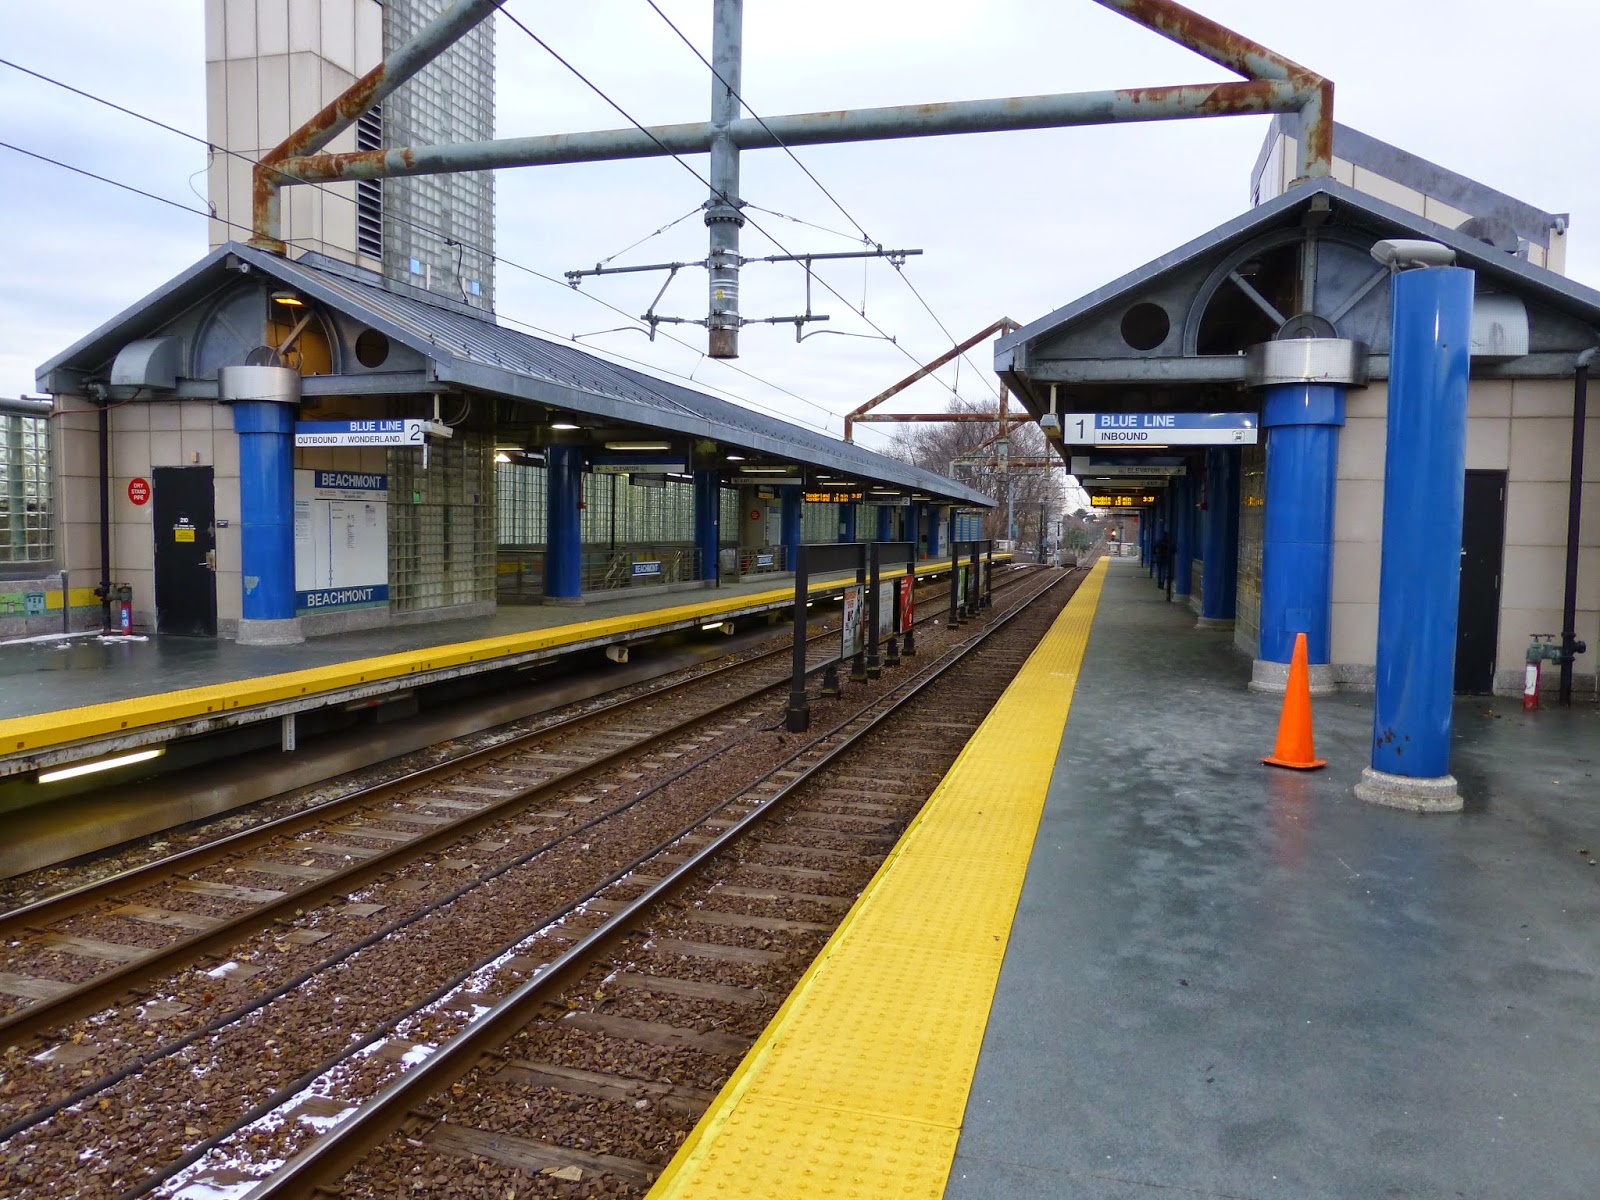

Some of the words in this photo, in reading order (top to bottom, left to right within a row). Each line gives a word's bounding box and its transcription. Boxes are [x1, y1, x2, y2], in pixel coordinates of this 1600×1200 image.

[350, 421, 376, 432] BLUE
[380, 421, 402, 431] LINE
[1101, 415, 1137, 427] BLUE
[1144, 415, 1175, 427] LINE
[410, 424, 420, 441] 2
[1075, 419, 1085, 439] 1
[297, 436, 338, 444] OUTBOUND
[1101, 432, 1148, 441] INBOUND
[321, 473, 382, 488] BEACHMONT
[903, 497, 909, 505] 2
[635, 564, 659, 573] BEACHMONT
[307, 588, 374, 607] BEACHMONT
